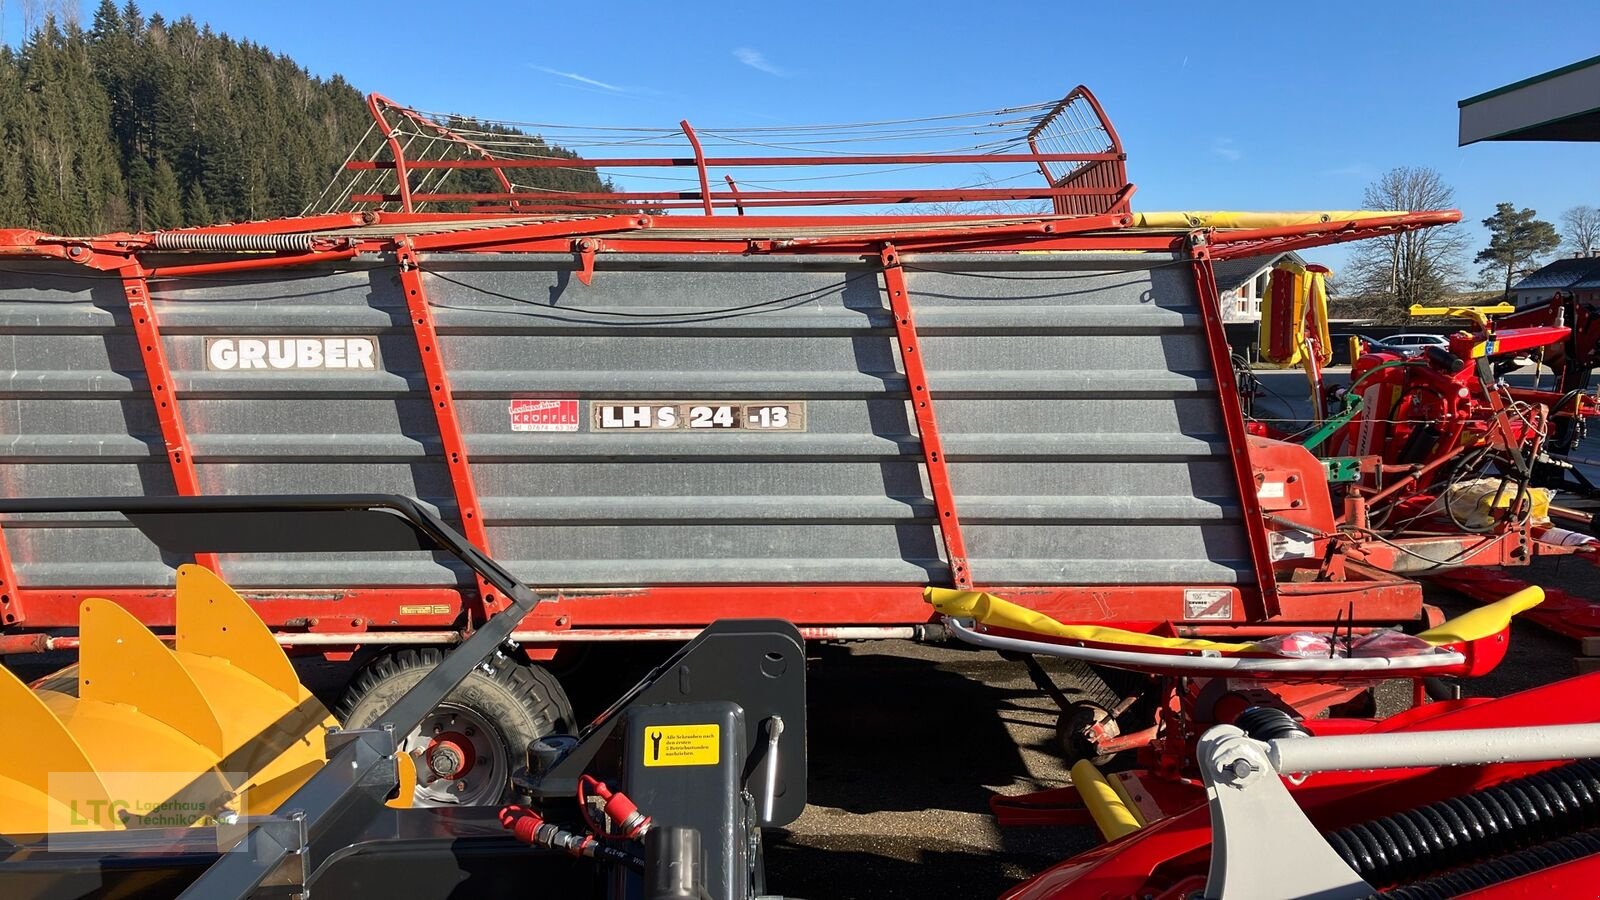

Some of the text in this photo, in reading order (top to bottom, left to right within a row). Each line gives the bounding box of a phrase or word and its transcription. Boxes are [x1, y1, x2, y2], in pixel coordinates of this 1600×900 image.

[210, 339, 374, 370] GRUBER
[690, 406, 734, 428] 24
[750, 406, 788, 428] -13
